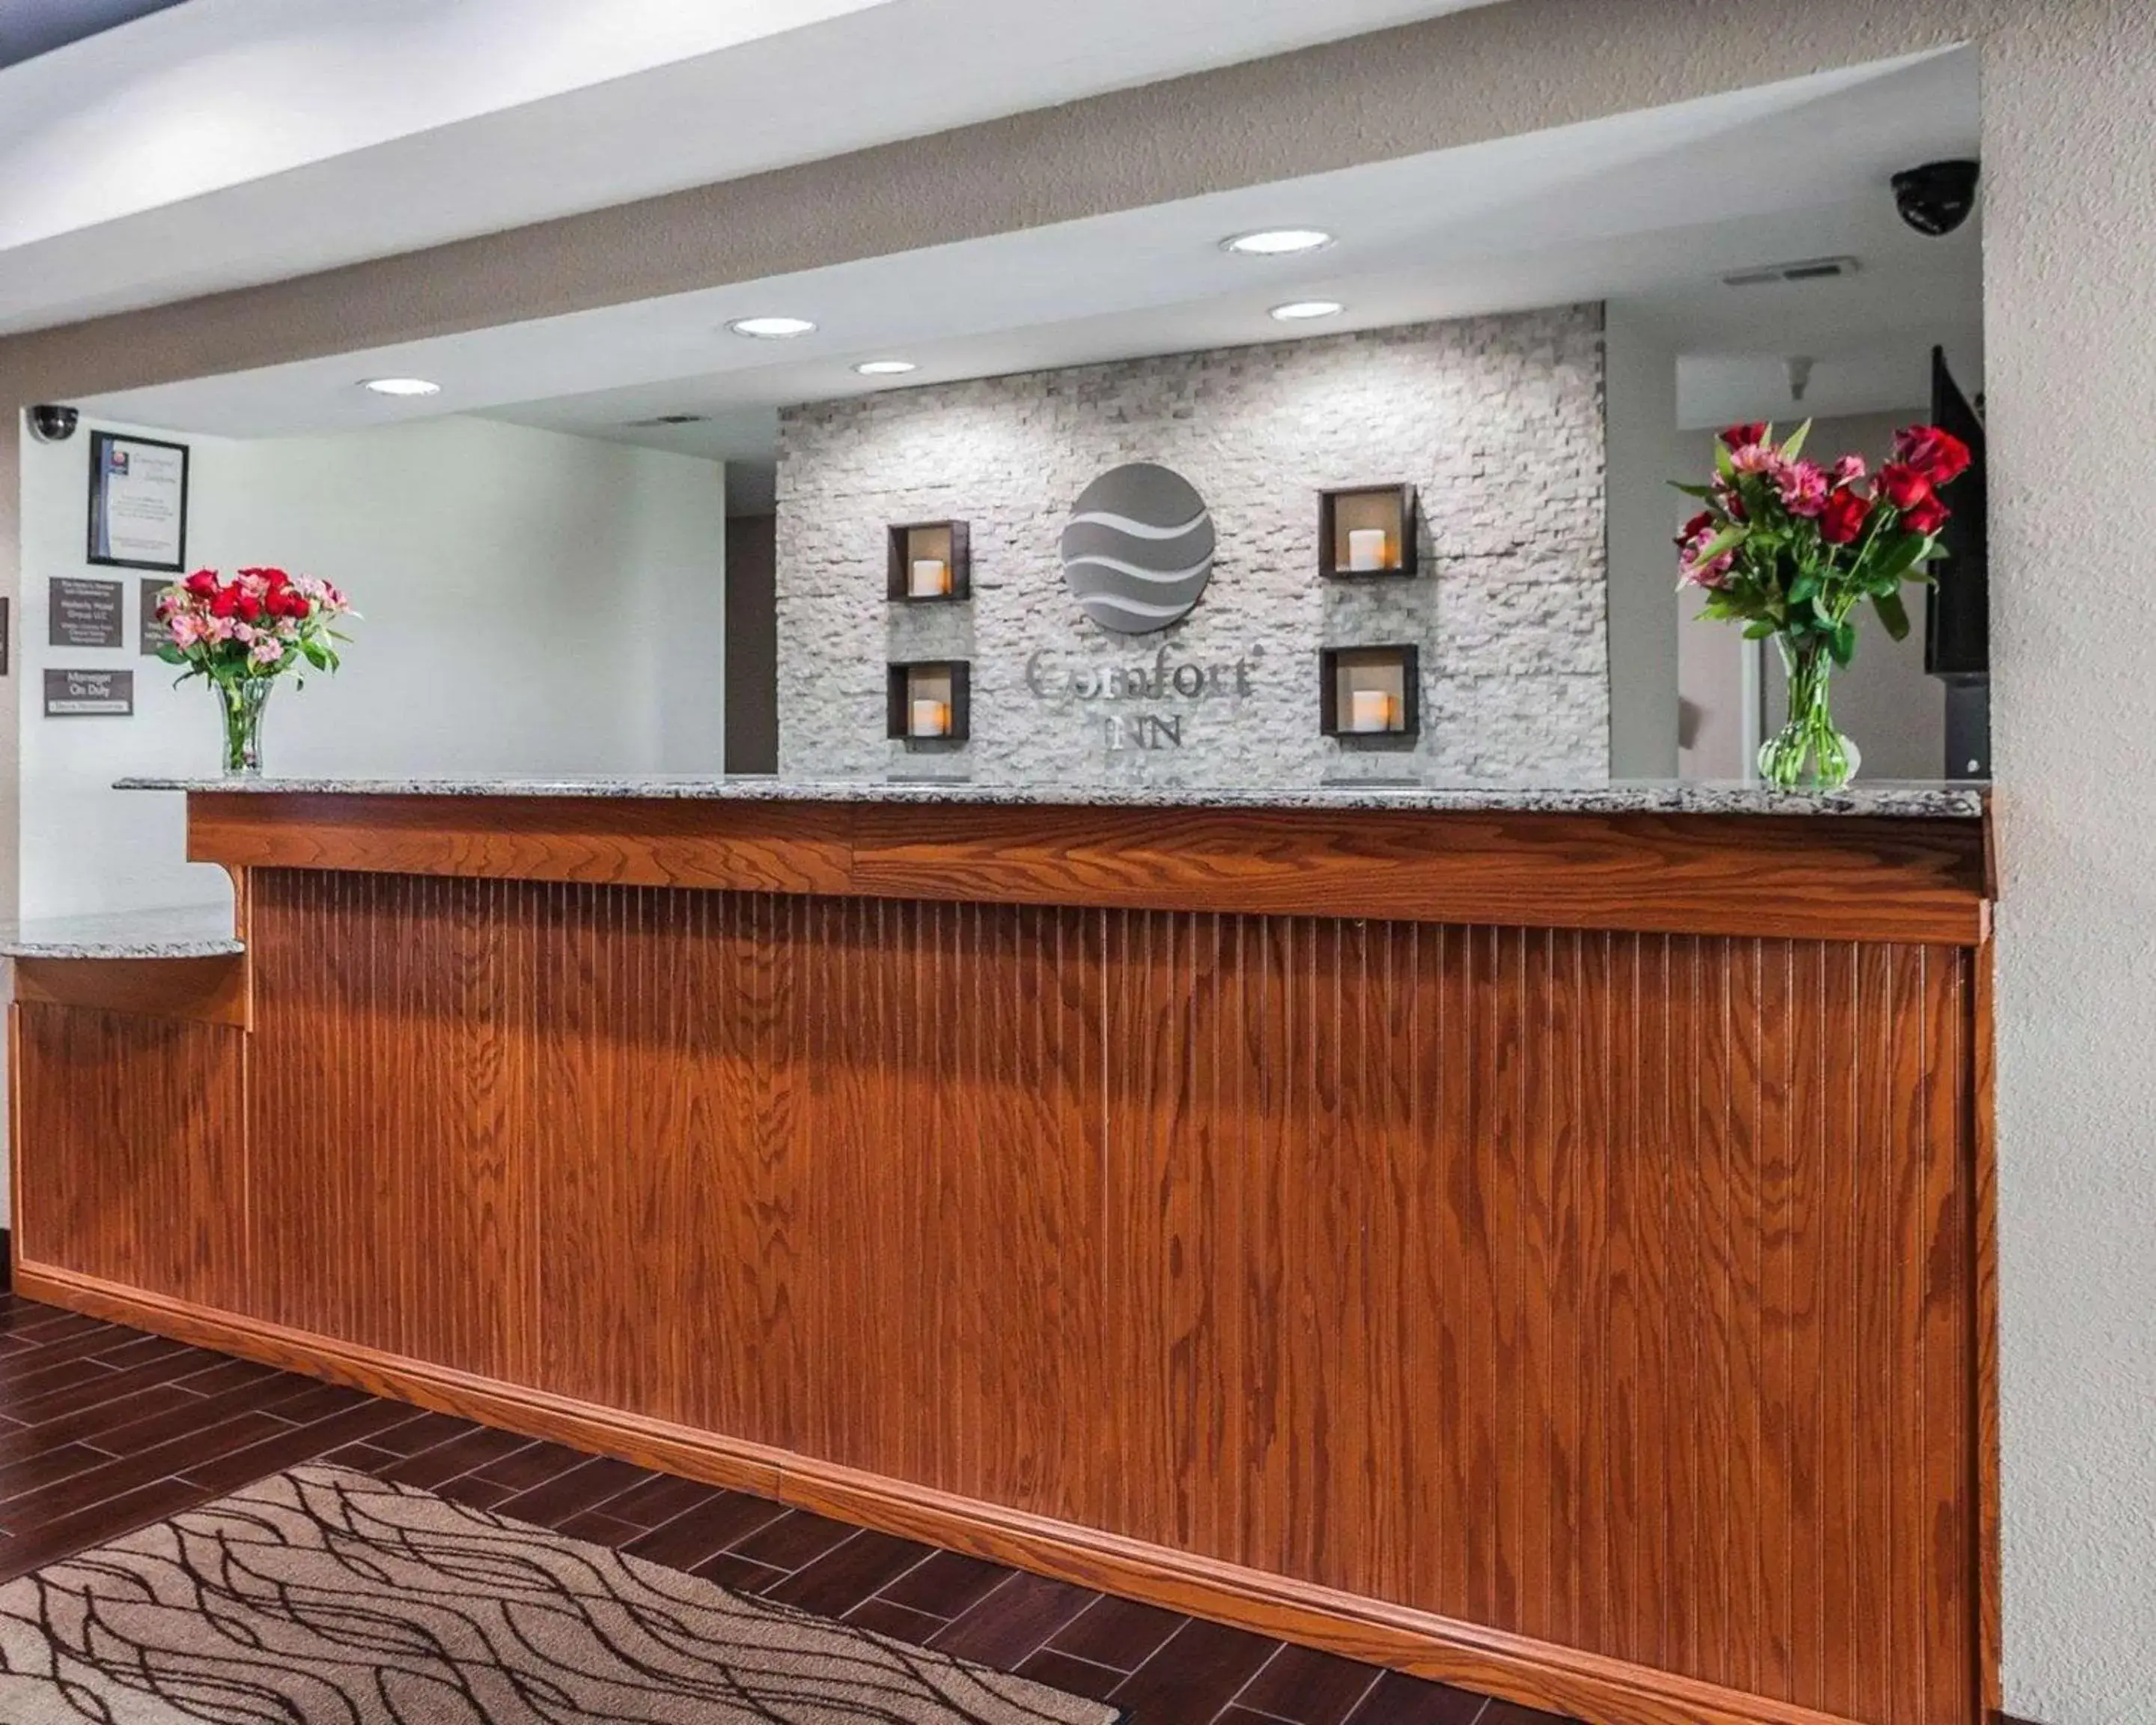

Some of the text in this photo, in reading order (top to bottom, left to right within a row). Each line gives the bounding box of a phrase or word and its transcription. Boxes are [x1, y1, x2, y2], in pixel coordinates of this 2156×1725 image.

[68, 672, 111, 687] Manager
[1025, 642, 1256, 701] Comfort
[70, 682, 110, 698] On Duty
[1104, 714, 1182, 749] INN
